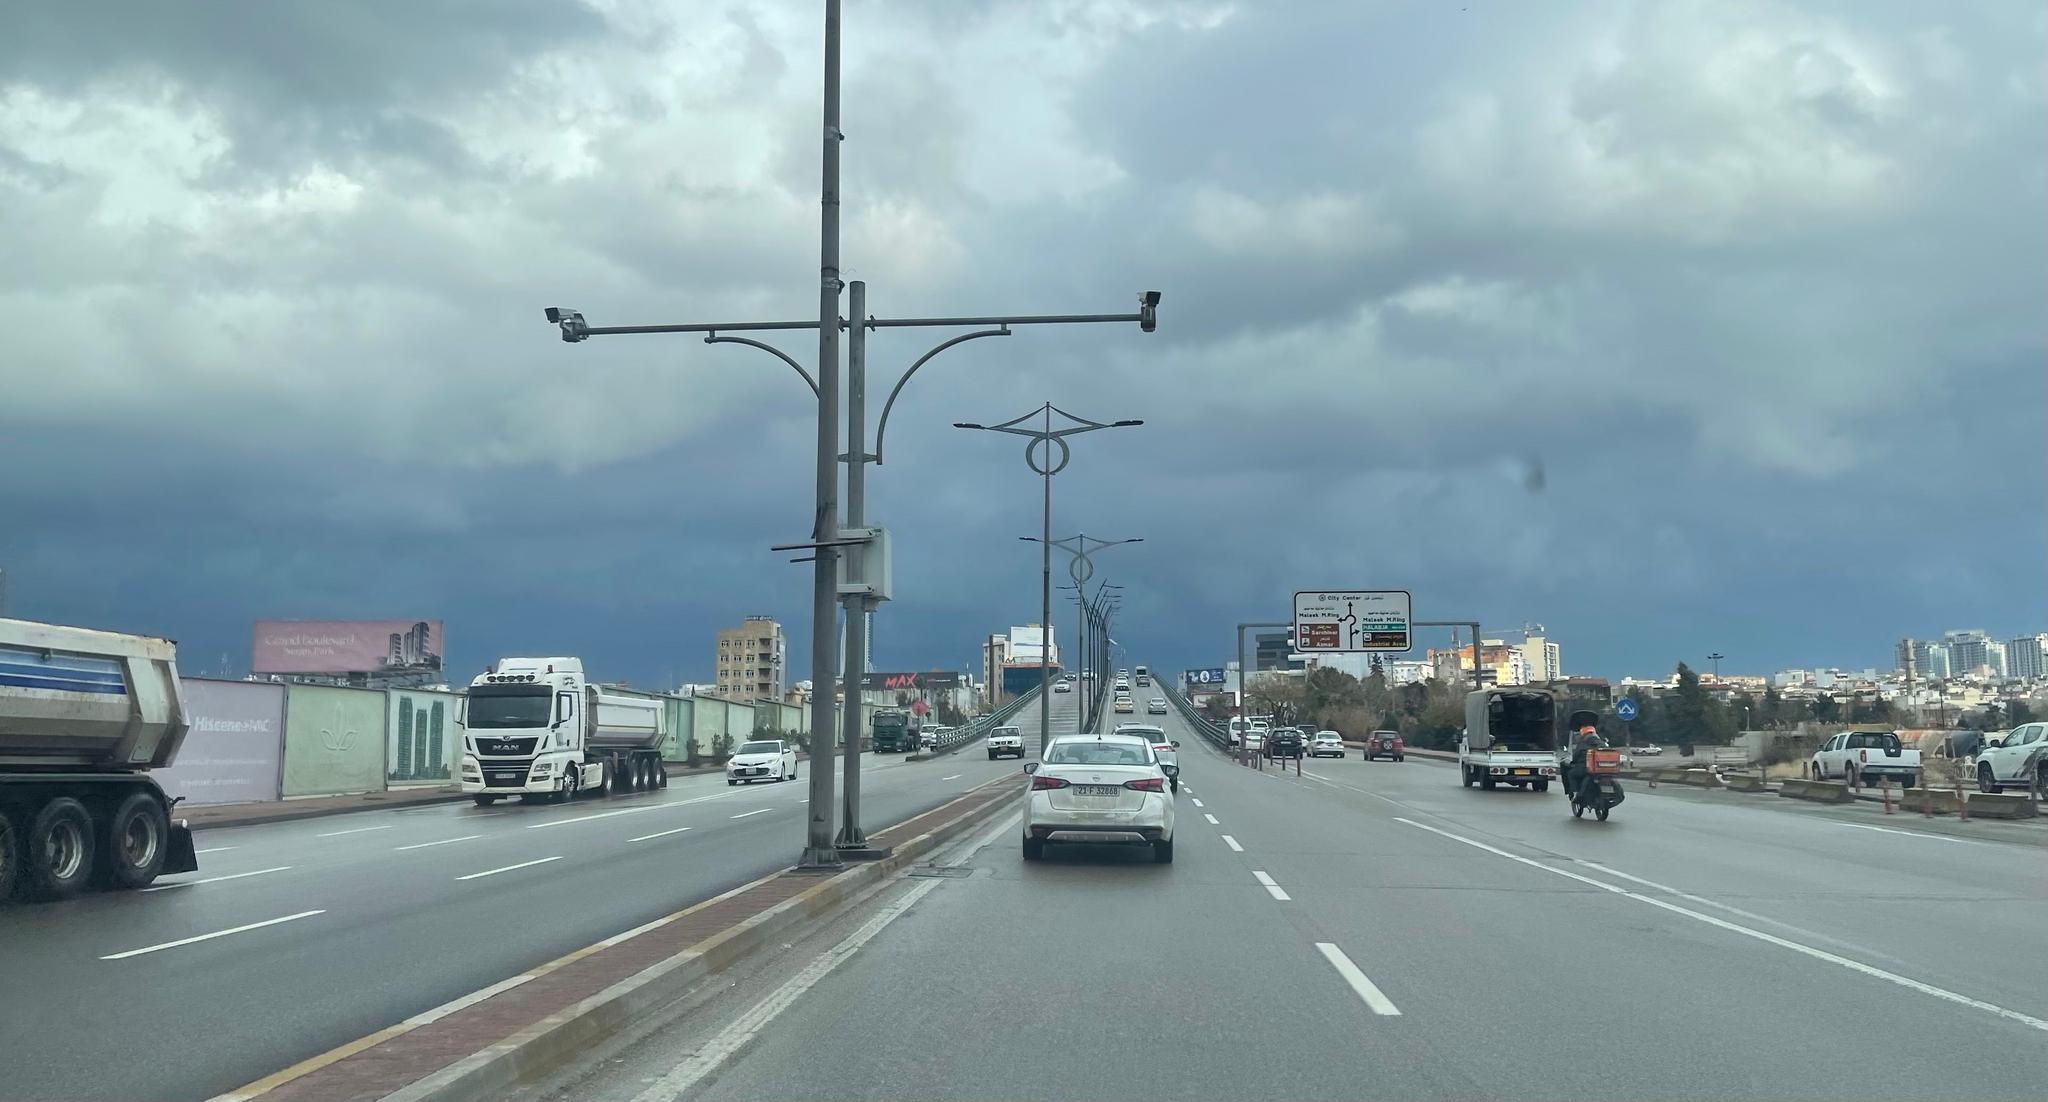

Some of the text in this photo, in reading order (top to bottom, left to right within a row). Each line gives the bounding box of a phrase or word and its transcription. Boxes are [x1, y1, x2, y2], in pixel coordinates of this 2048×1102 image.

[885, 672, 918, 688] MAX
[1078, 786, 1087, 794] 21
[1089, 786, 1095, 794] F
